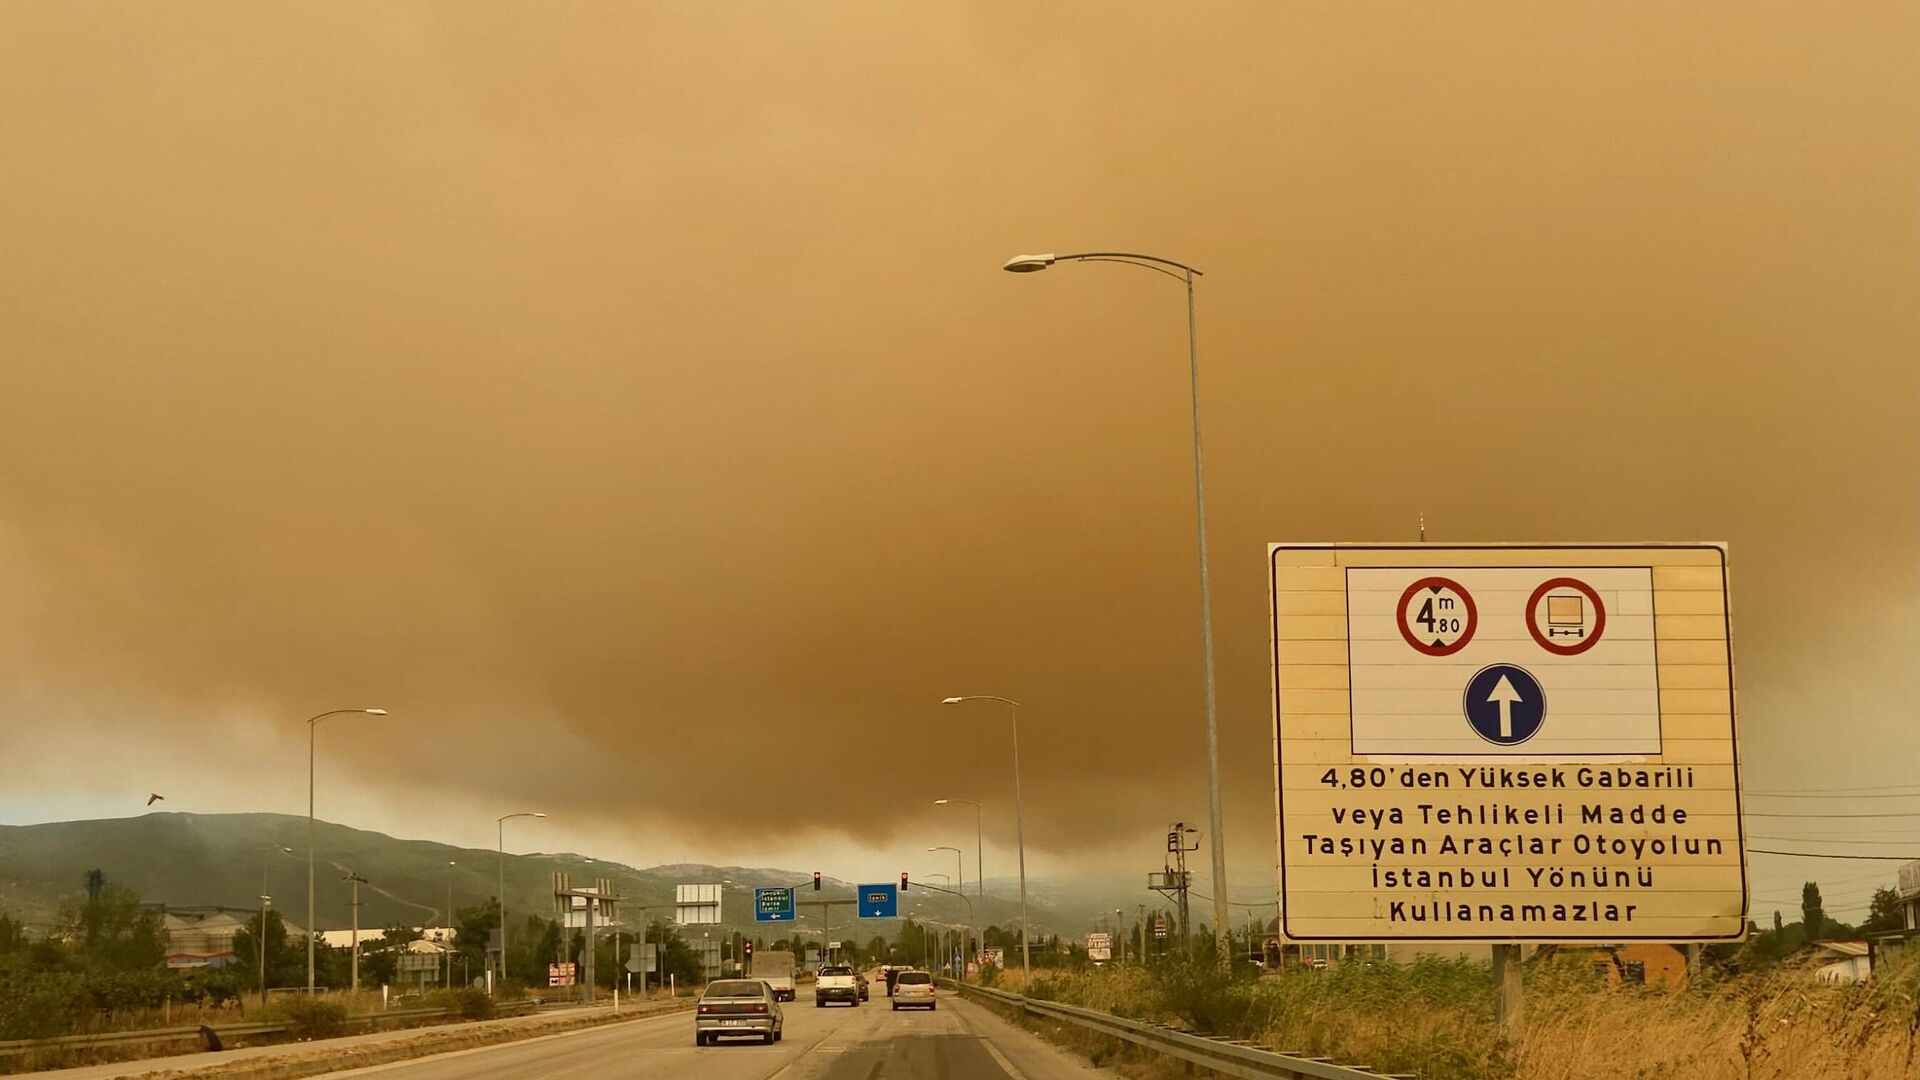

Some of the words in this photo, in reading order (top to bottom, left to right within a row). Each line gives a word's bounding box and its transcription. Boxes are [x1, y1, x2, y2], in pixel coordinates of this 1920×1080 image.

[1458, 766, 1566, 788] Yüksek
[1576, 766, 1693, 788] Gabarili
[1331, 807, 1404, 831] veya
[1417, 803, 1563, 825] Tehlikeli
[1581, 804, 1687, 825] Madde
[1302, 834, 1427, 861] Taşıyan
[1439, 834, 1562, 859] Araçlar
[1573, 833, 1722, 861] Otoyolun
[1372, 862, 1509, 888] İstanbul
[1525, 866, 1653, 888] Yönünü
[1390, 901, 1637, 922] Kullanamazlar
